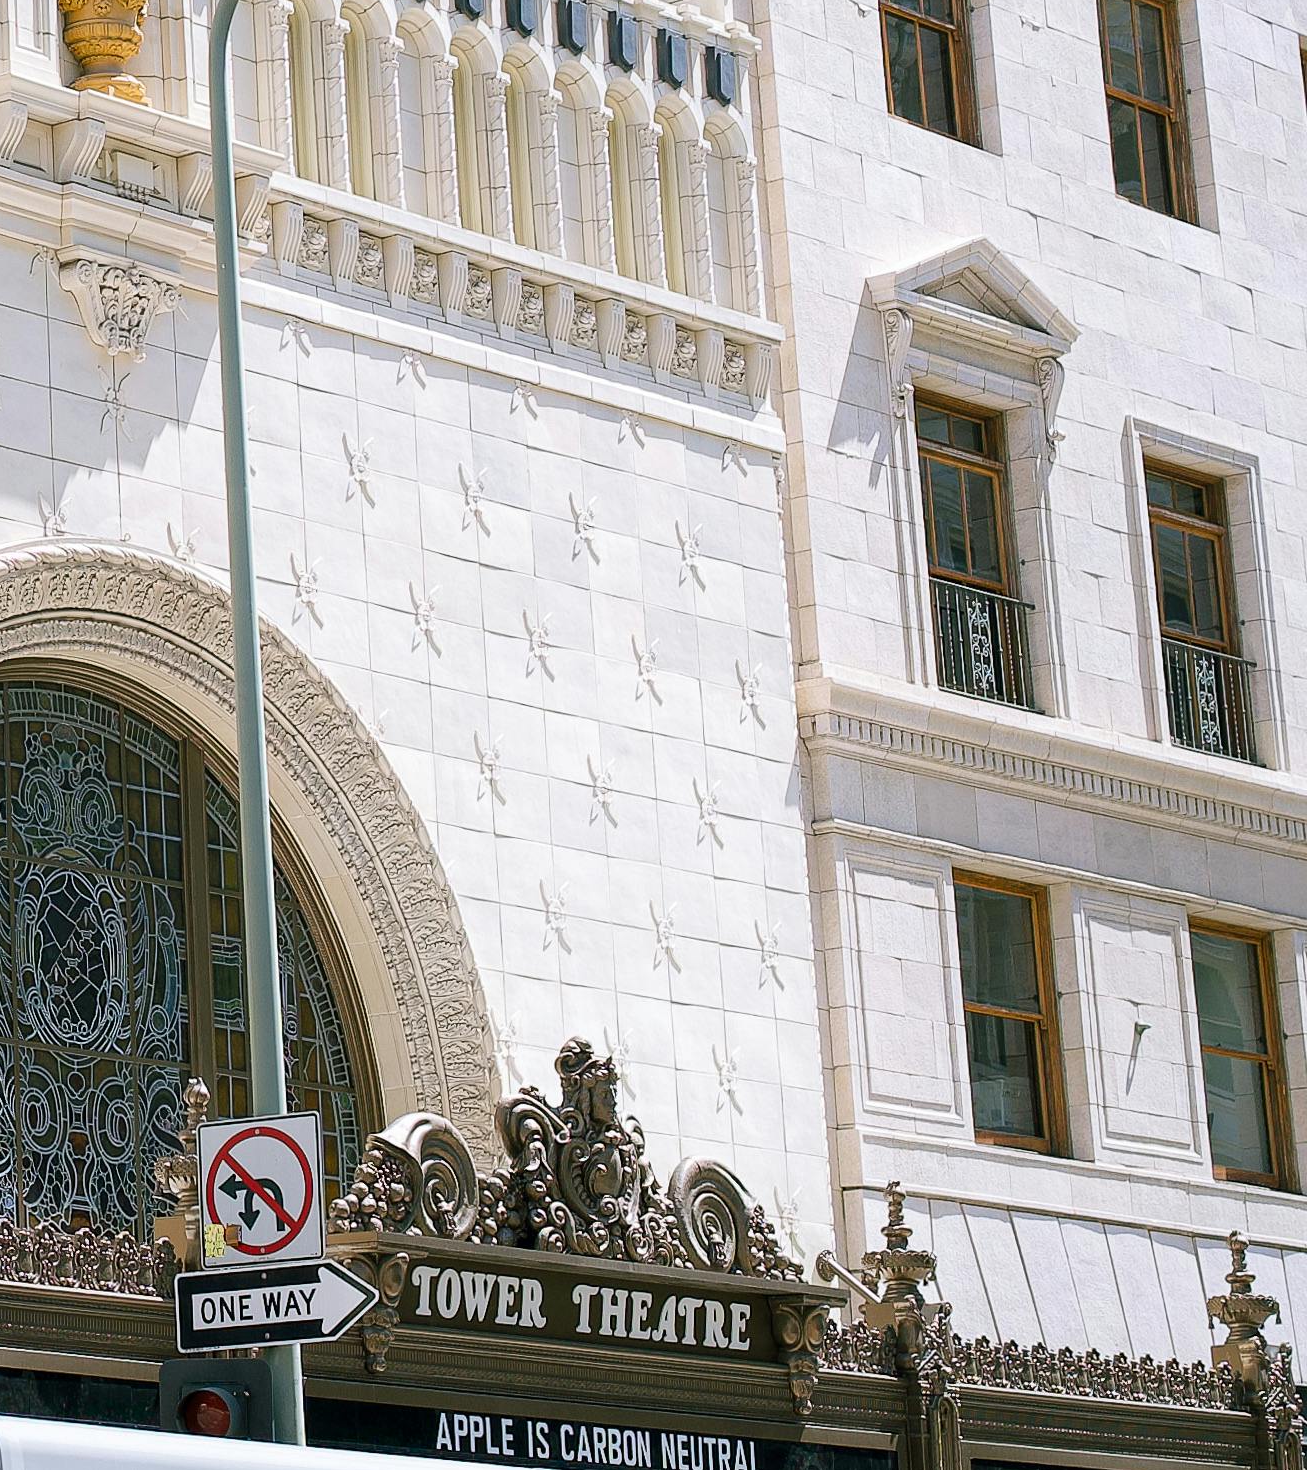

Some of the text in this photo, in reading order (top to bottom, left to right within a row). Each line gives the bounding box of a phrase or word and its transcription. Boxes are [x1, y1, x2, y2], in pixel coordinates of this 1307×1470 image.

[200, 1287, 317, 1325] ONE WAY
[411, 1264, 752, 1352] TOWER THEATRE
[435, 1412, 515, 1458] APPLE
[526, 1420, 551, 1461] IS
[559, 1424, 652, 1470] CARBON
